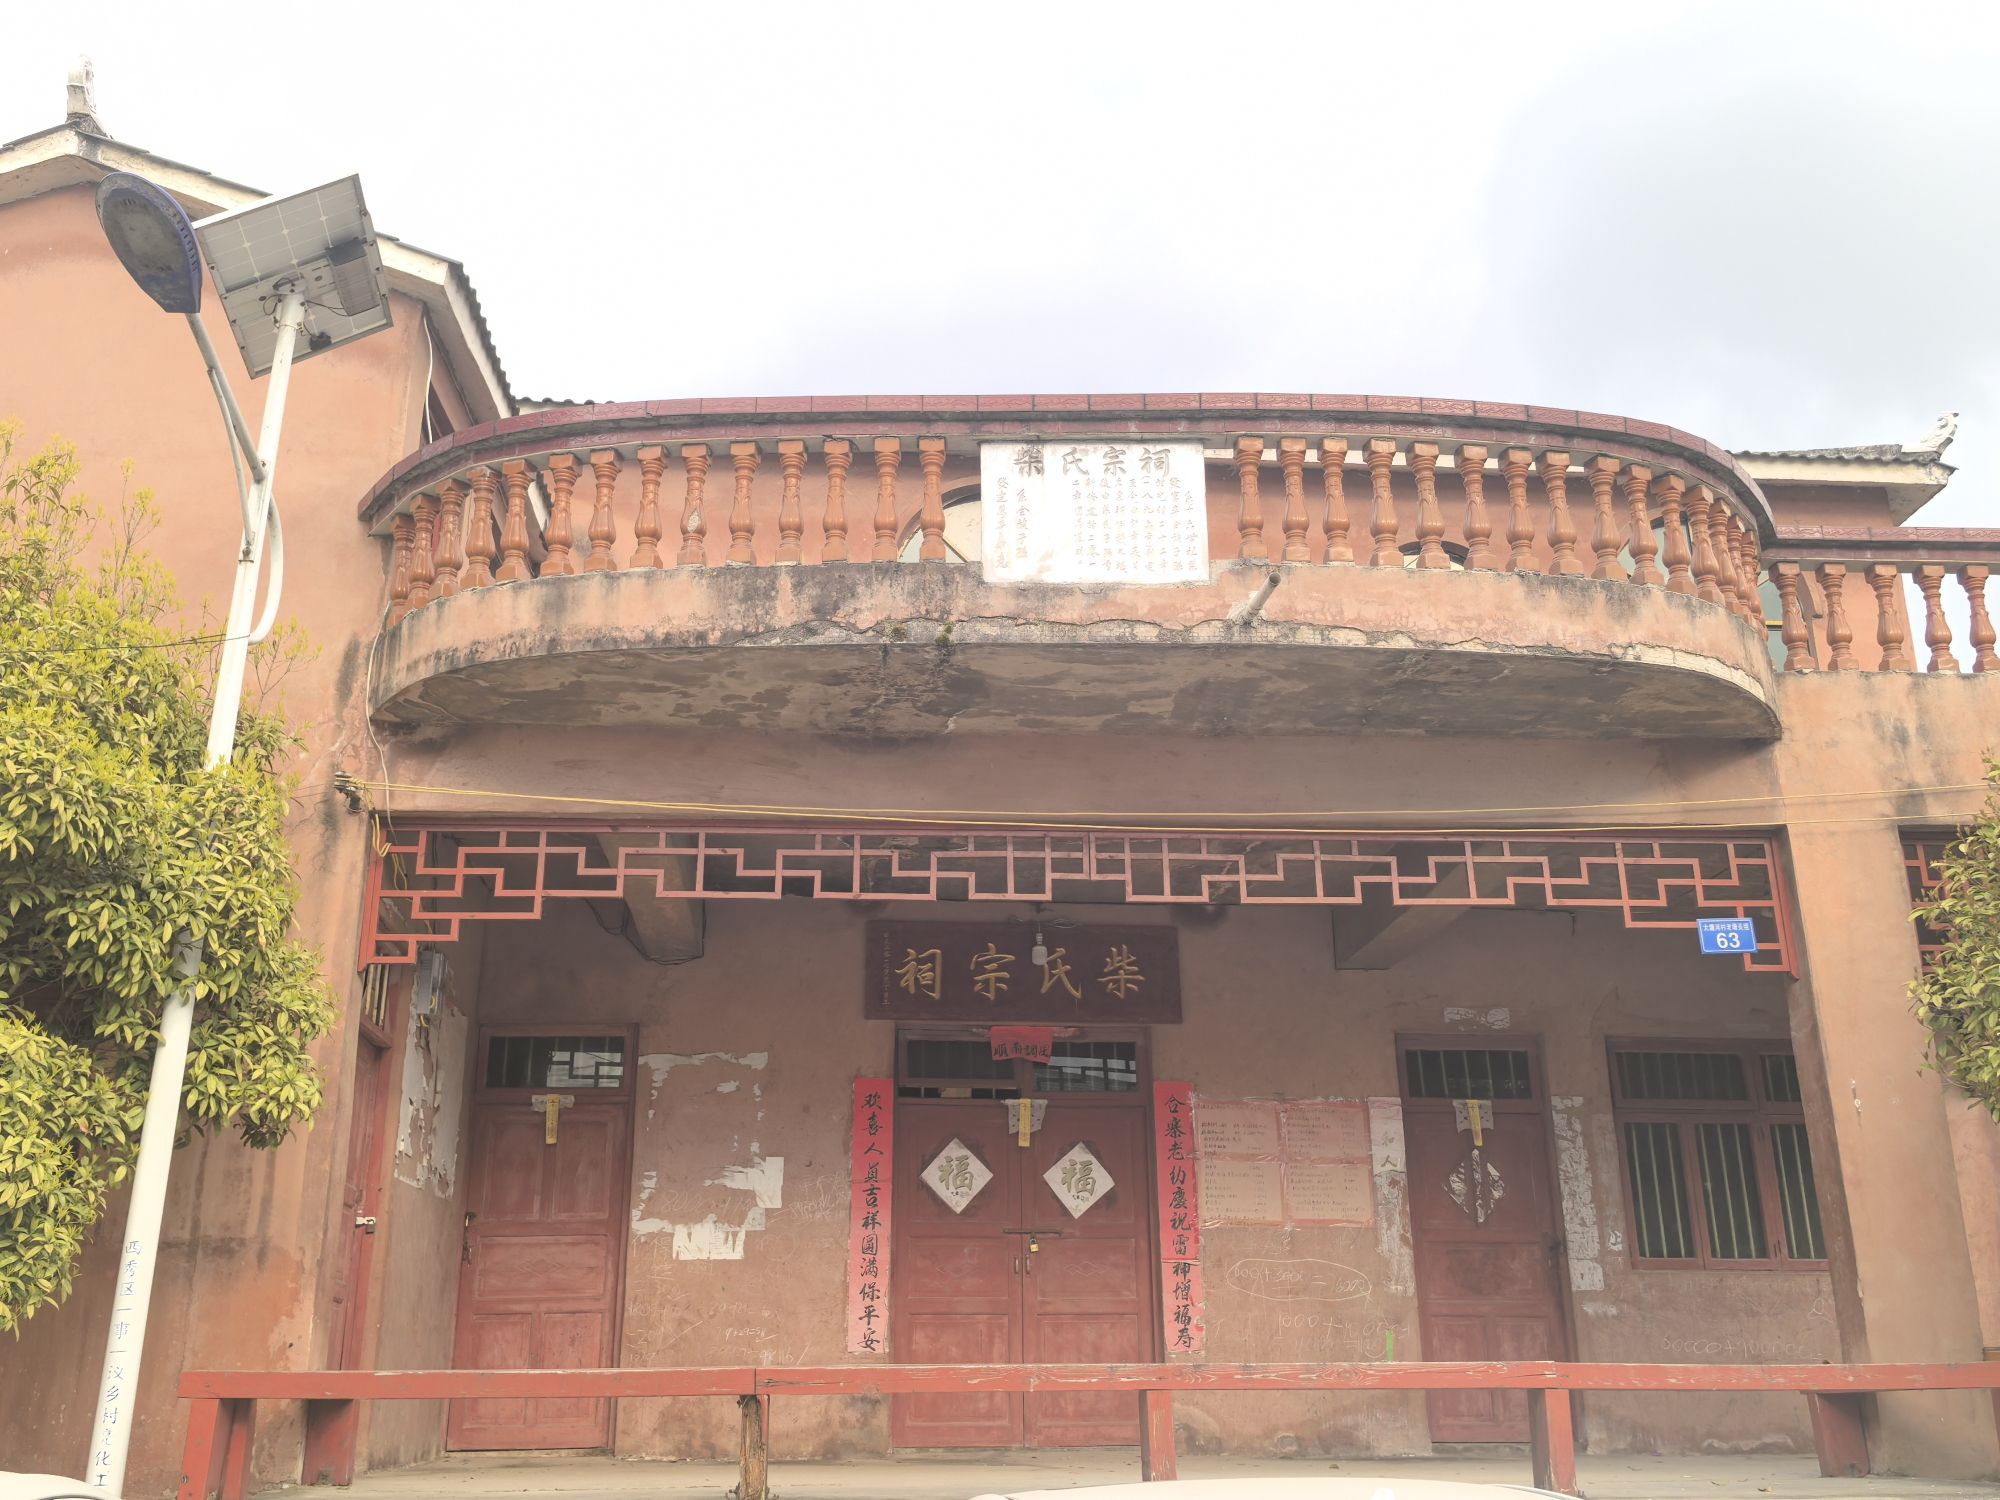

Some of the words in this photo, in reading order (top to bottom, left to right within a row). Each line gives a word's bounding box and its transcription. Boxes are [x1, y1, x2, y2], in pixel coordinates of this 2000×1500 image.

[1716, 932, 1741, 949] 63
[895, 942, 1146, 1001] 柴氏宗祠
[937, 1154, 975, 1193] 福
[1060, 1158, 1098, 1198] 福
